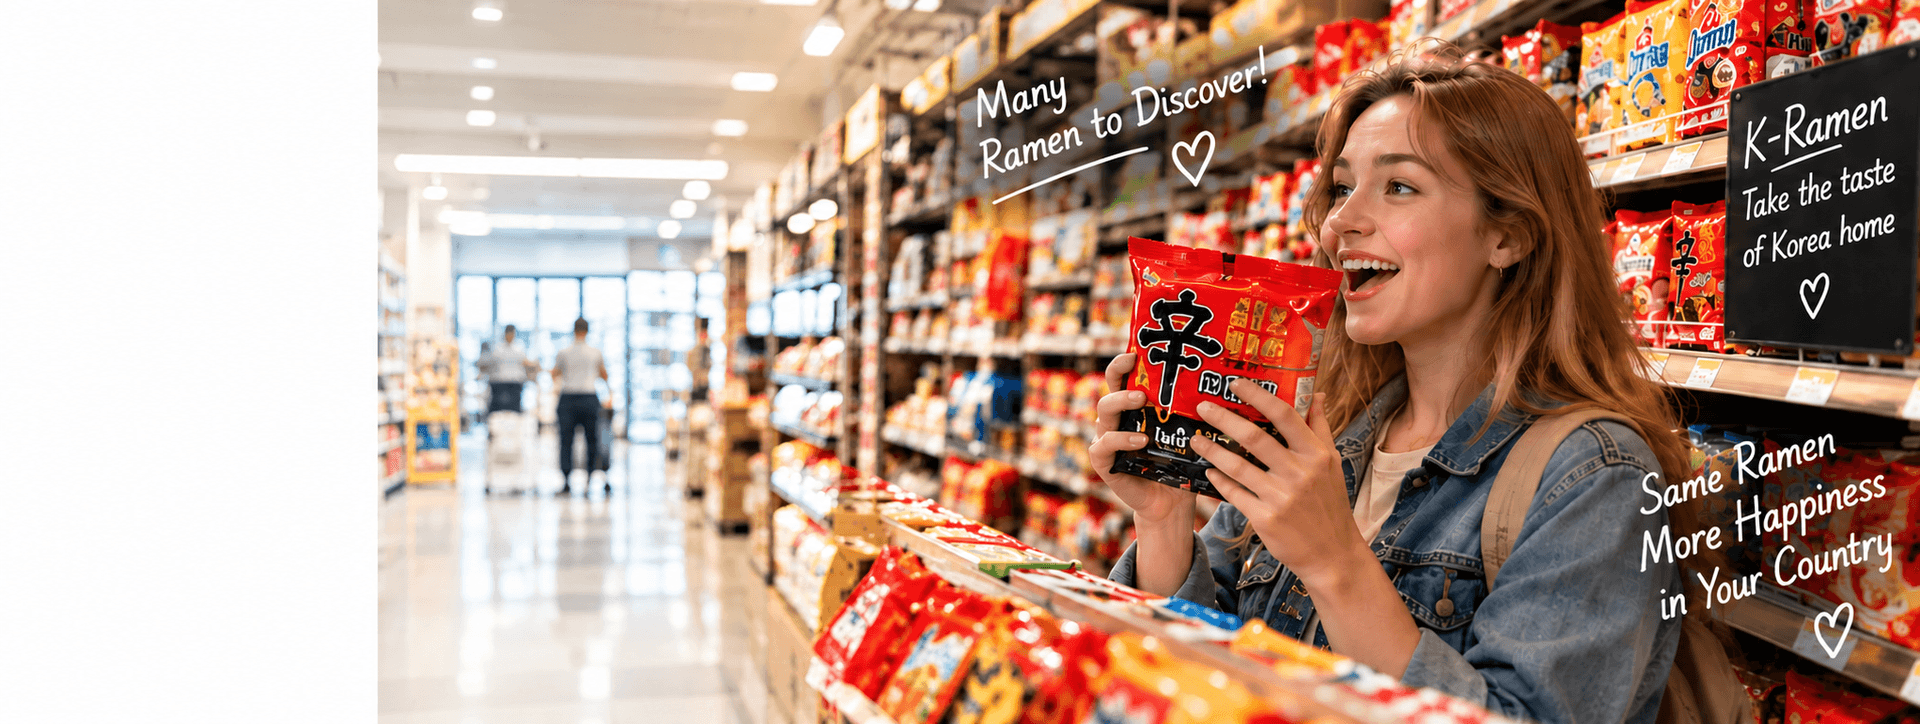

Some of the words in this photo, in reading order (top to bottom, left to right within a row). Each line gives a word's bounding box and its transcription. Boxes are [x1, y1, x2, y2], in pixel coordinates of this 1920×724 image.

[1744, 96, 1889, 170] K-Ramen
[1742, 182, 1790, 221] Take
[1798, 172, 1832, 206] the
[1840, 158, 1896, 195] taste
[1743, 234, 1767, 268] of
[1772, 229, 1832, 262] Korea
[1840, 214, 1896, 246] home
[1138, 288, 1223, 408] 辛
